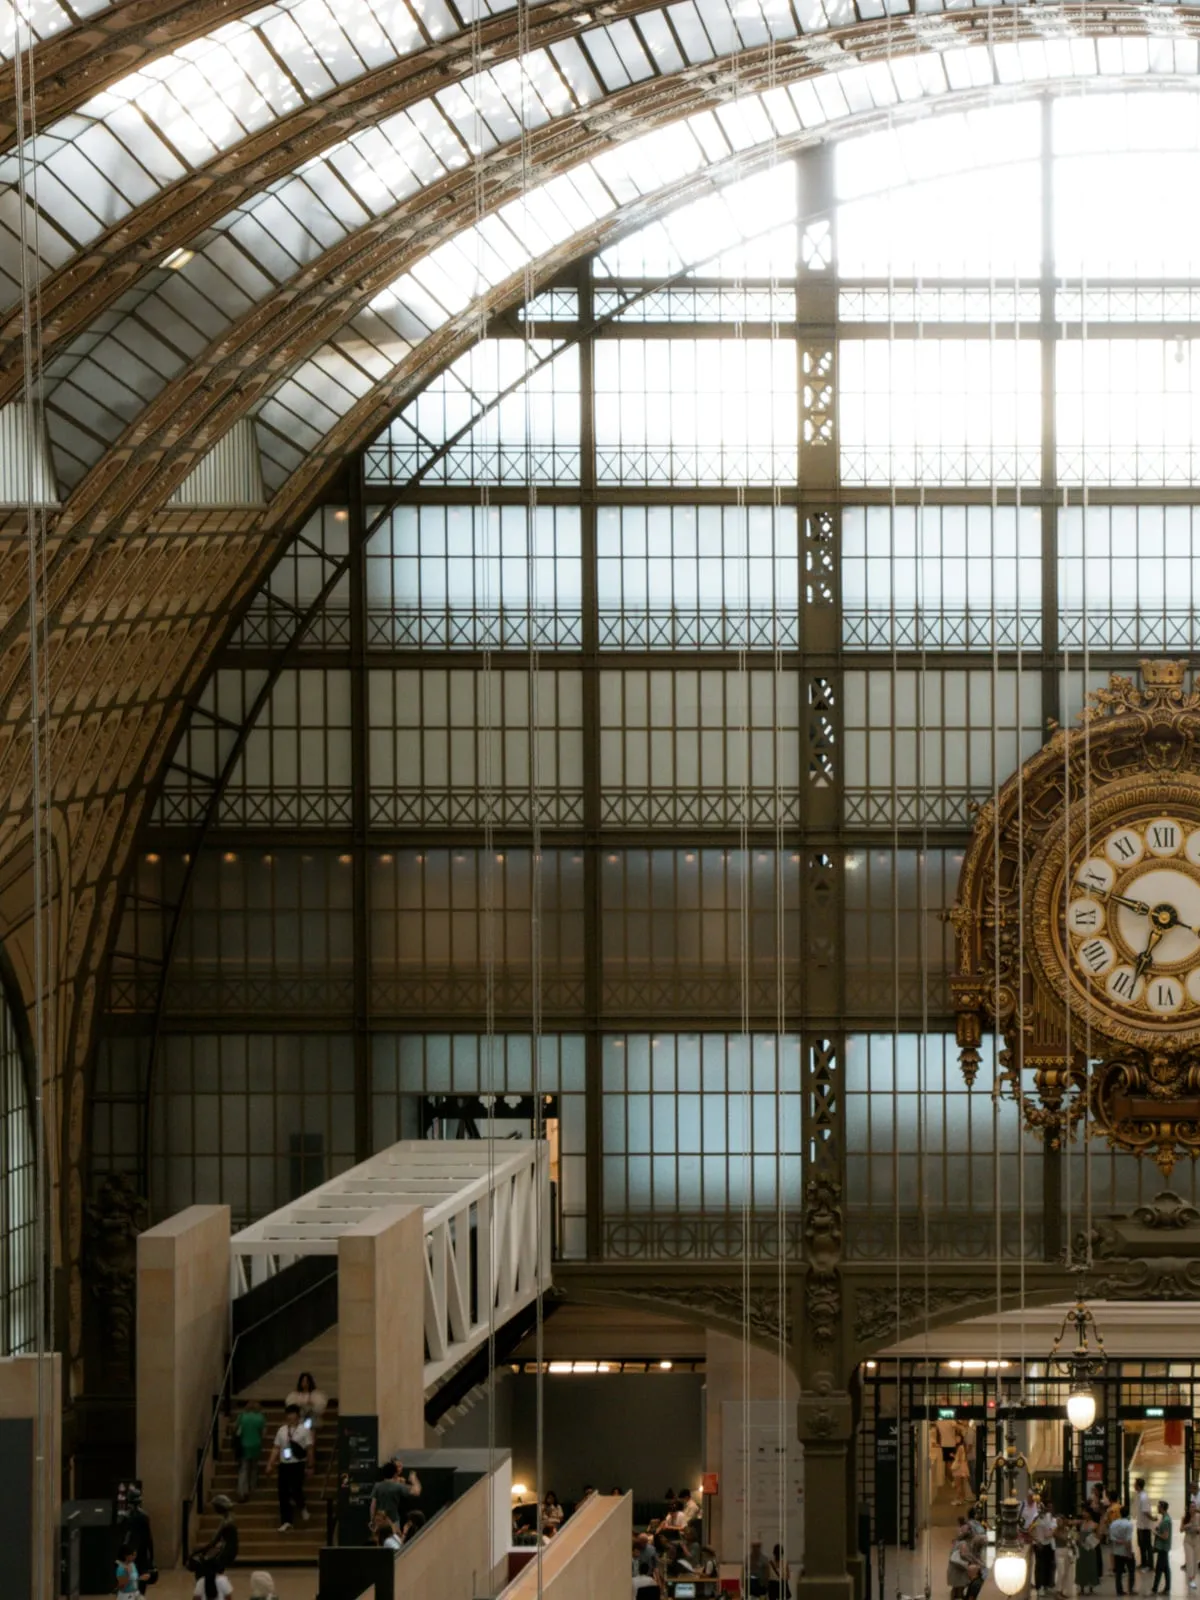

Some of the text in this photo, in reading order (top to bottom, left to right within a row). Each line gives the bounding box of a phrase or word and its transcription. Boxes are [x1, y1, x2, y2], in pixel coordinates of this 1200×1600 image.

[1153, 827, 1175, 847] XII
[1114, 836, 1136, 860] XI
[1086, 868, 1106, 886] X
[1076, 909, 1096, 925] IX
[1082, 940, 1109, 972] VIII
[1112, 972, 1136, 1000] VII
[1158, 986, 1175, 1005] VI
